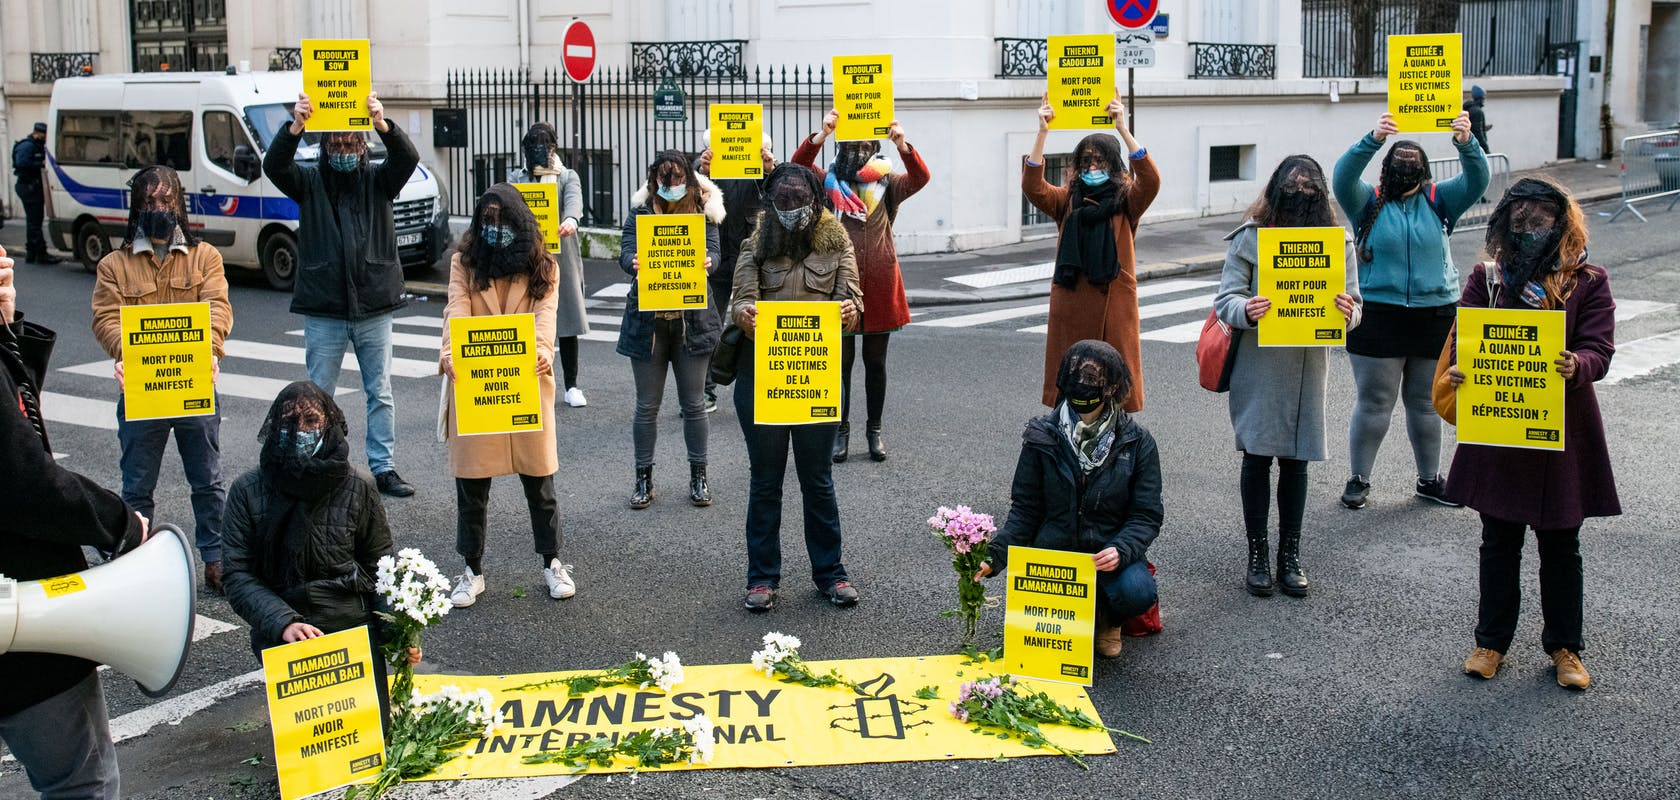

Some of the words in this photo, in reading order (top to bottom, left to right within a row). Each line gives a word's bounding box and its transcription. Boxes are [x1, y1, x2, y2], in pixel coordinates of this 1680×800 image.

[1404, 58, 1408, 67] À
[1063, 98, 1100, 107] MANIFESTÉ
[1399, 104, 1445, 113] RÉPRESSION
[652, 238, 656, 246] À
[1283, 244, 1320, 253] THIERNO
[1277, 258, 1306, 267] SADOU
[1309, 257, 1326, 267] BAH
[648, 282, 691, 290] RÉPRESSION
[1277, 281, 1300, 289] MORT
[1303, 281, 1326, 289] POUR
[1289, 295, 1314, 303] AVOIR
[1278, 306, 1325, 317] MANIFESTÉ
[144, 319, 188, 329] MAMADOU
[133, 332, 180, 344] LAMARANA
[182, 331, 200, 341] BAH
[472, 331, 514, 342] MAMADOU
[774, 330, 778, 341] À
[782, 332, 810, 341] QUAND
[814, 332, 823, 341] LA
[464, 346, 491, 356] KARFA
[494, 344, 523, 355] DIALLO
[768, 347, 801, 356] JUSTICE
[805, 347, 828, 356] POUR
[1480, 340, 1485, 353] À
[1490, 343, 1524, 354] QUAND
[1529, 345, 1541, 356] LA
[142, 355, 166, 365] MORT
[170, 354, 193, 363] POUR
[1473, 358, 1514, 371] JUSTICE
[1518, 361, 1547, 372] POUR
[770, 361, 784, 370] LES
[787, 361, 827, 370] VICTIMES
[156, 368, 181, 378] AVOIR
[471, 369, 494, 378] MORT
[497, 367, 520, 377] POUR
[145, 378, 193, 391] MANIFESTÉ
[786, 375, 797, 384] DE
[800, 375, 810, 384] LA
[1474, 374, 1492, 385] LES
[1496, 376, 1546, 388] VICTIMES
[484, 382, 509, 392] AVOIR
[474, 392, 521, 405] MANIFESTÉ
[768, 387, 820, 399] RÉPRESSION
[1495, 392, 1508, 402] DE
[1513, 392, 1524, 403] LA
[1472, 404, 1538, 420] RÉPRESSION
[1030, 565, 1073, 579] MAMADOU
[1018, 579, 1064, 594] LAMARANA
[1066, 584, 1084, 596] BAH
[1024, 605, 1048, 618] MORT
[1052, 609, 1075, 620] POUR
[1036, 622, 1061, 635] AVOIR
[1024, 636, 1072, 651] MANIFESTÉ
[292, 652, 345, 675] MAMADOU
[281, 672, 337, 697] LAMARANA
[339, 666, 360, 682] BAH
[295, 705, 324, 724] MORT
[328, 697, 356, 715] POUR
[500, 689, 782, 728] AMNESTY
[313, 719, 343, 737] AVOIR
[301, 729, 359, 758] MANIFESTÉ
